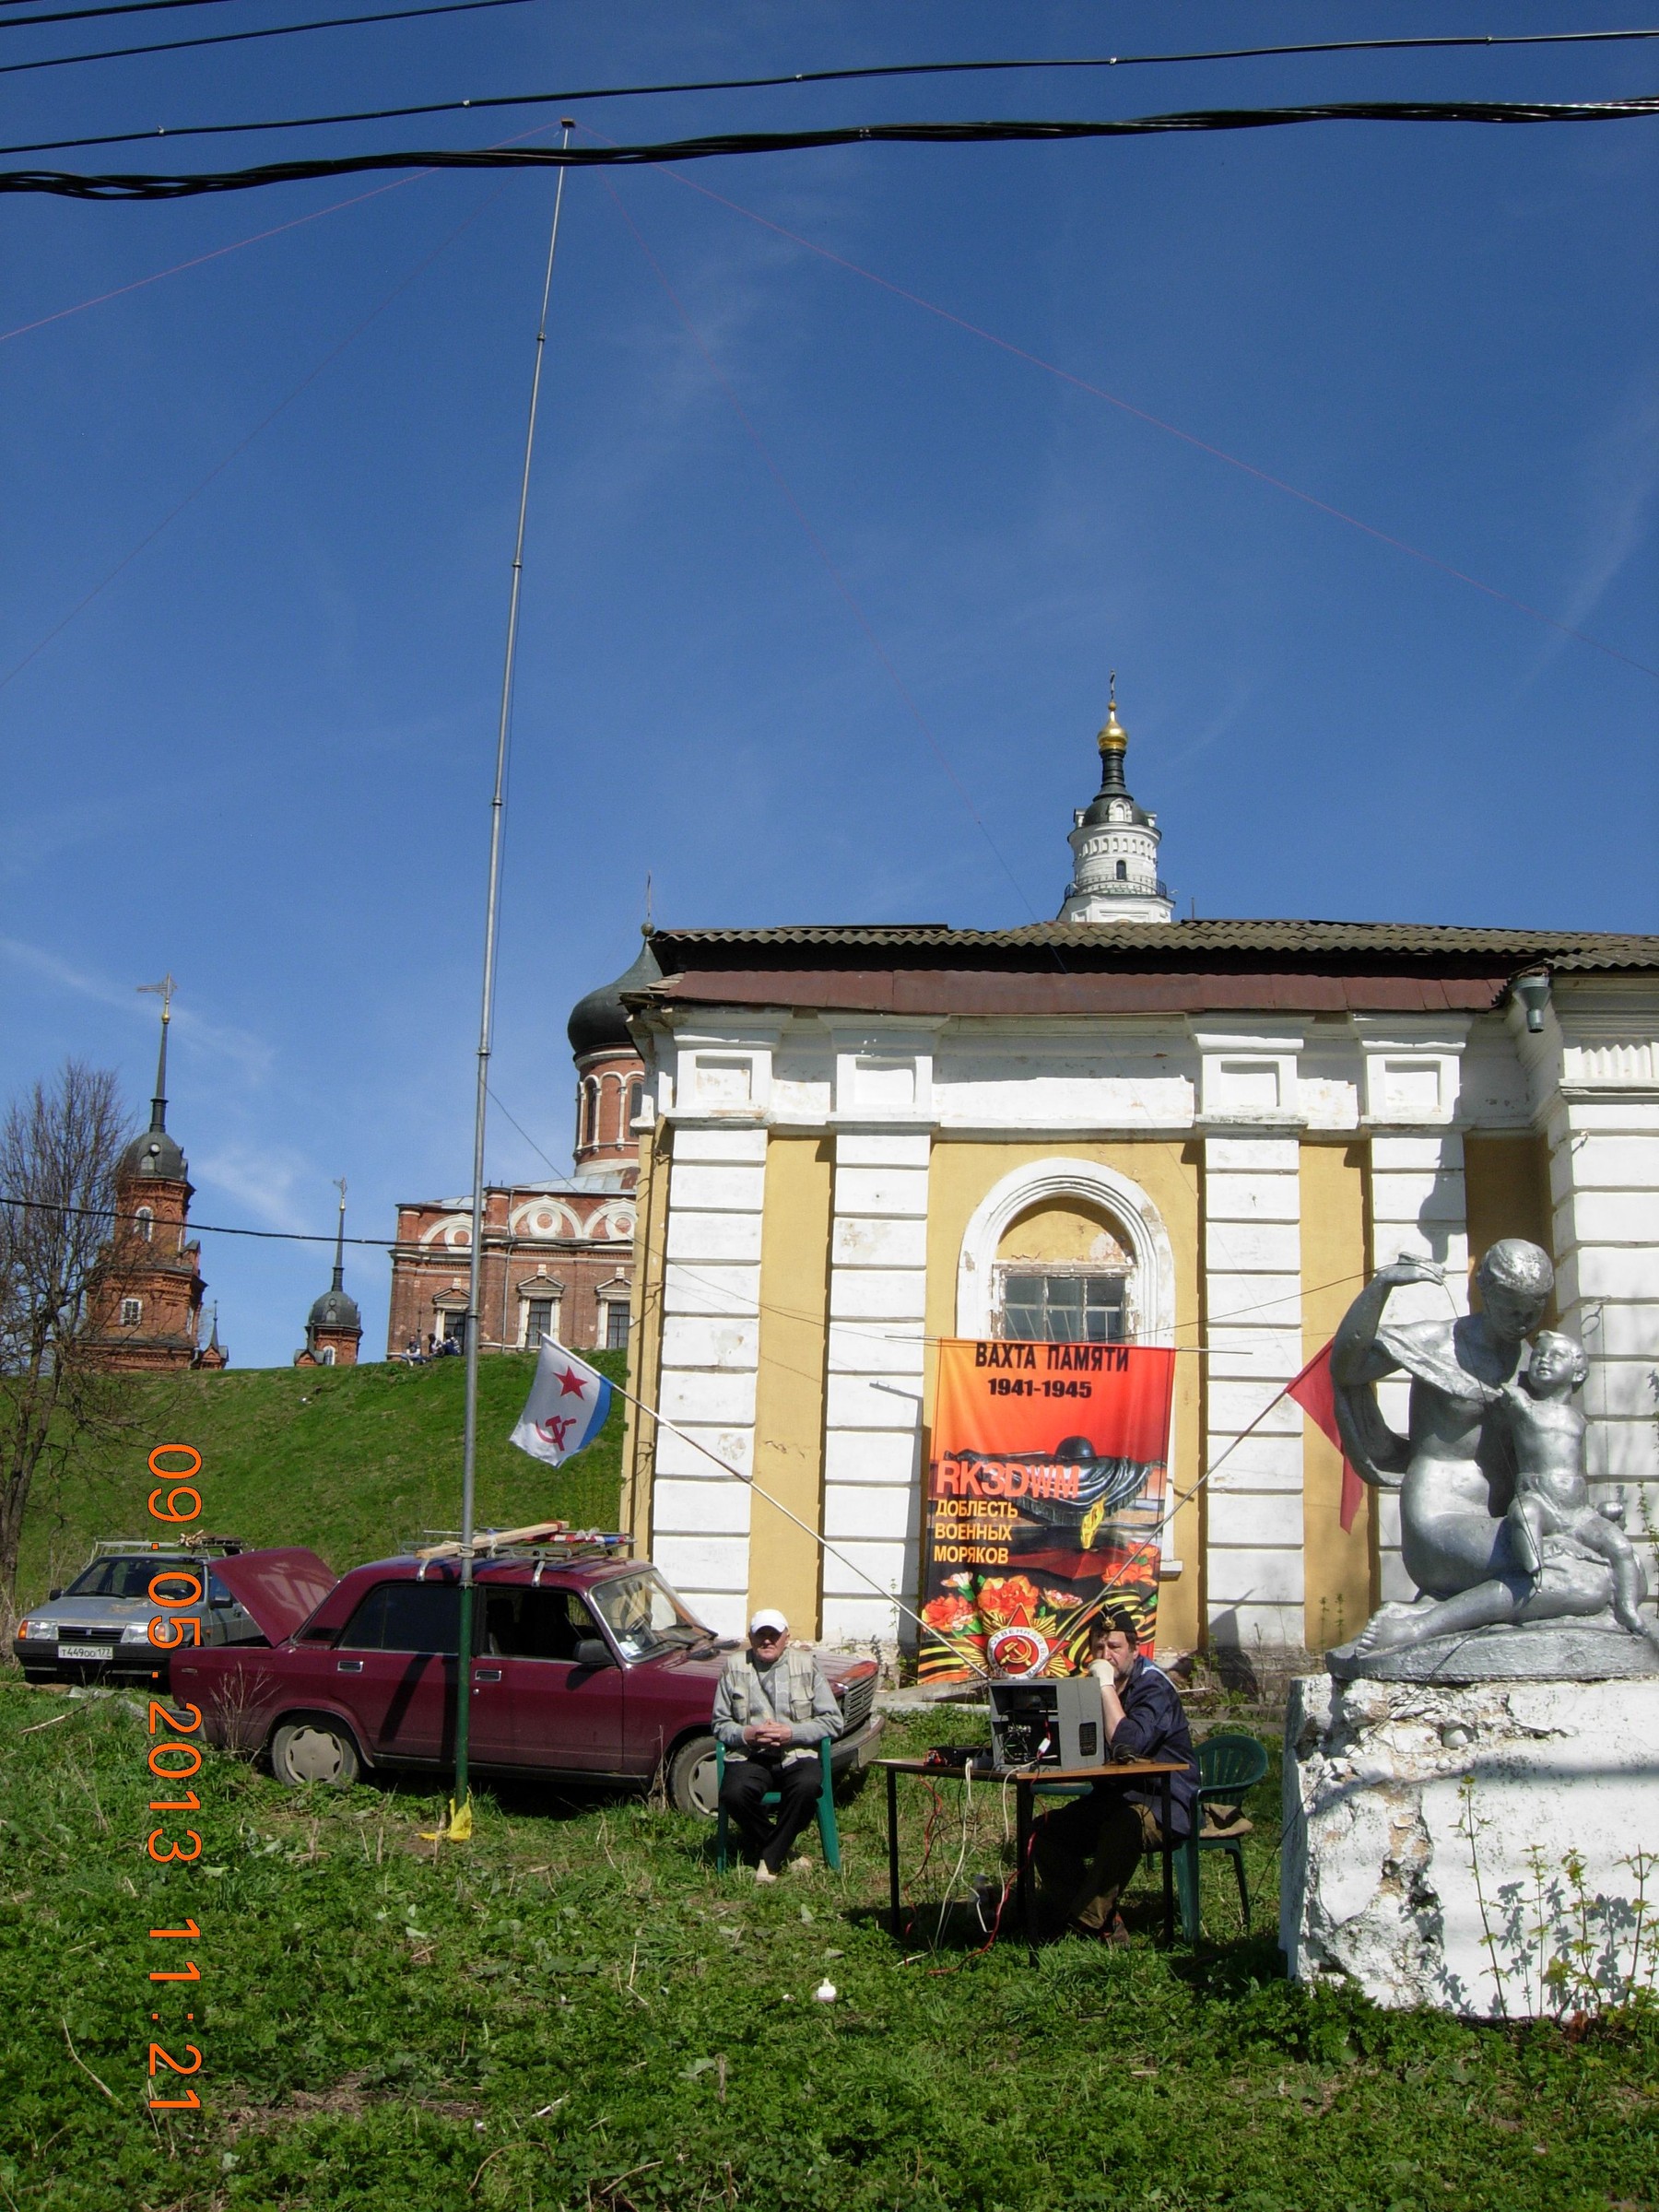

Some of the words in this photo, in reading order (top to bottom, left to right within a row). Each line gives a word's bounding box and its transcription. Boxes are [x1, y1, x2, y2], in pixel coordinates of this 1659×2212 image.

[975, 1343, 1036, 1370] ВАХТА
[1047, 1345, 1129, 1372] ПАМЯТИ
[988, 1378, 1092, 1398] 1941-1945
[936, 1459, 1081, 1499] RK3DWM
[935, 1500, 1018, 1518] ДОБЛЕСТЬ
[935, 1523, 1012, 1541] ВОЕННЫХ
[934, 1545, 1009, 1564] МОРЯКОВ
